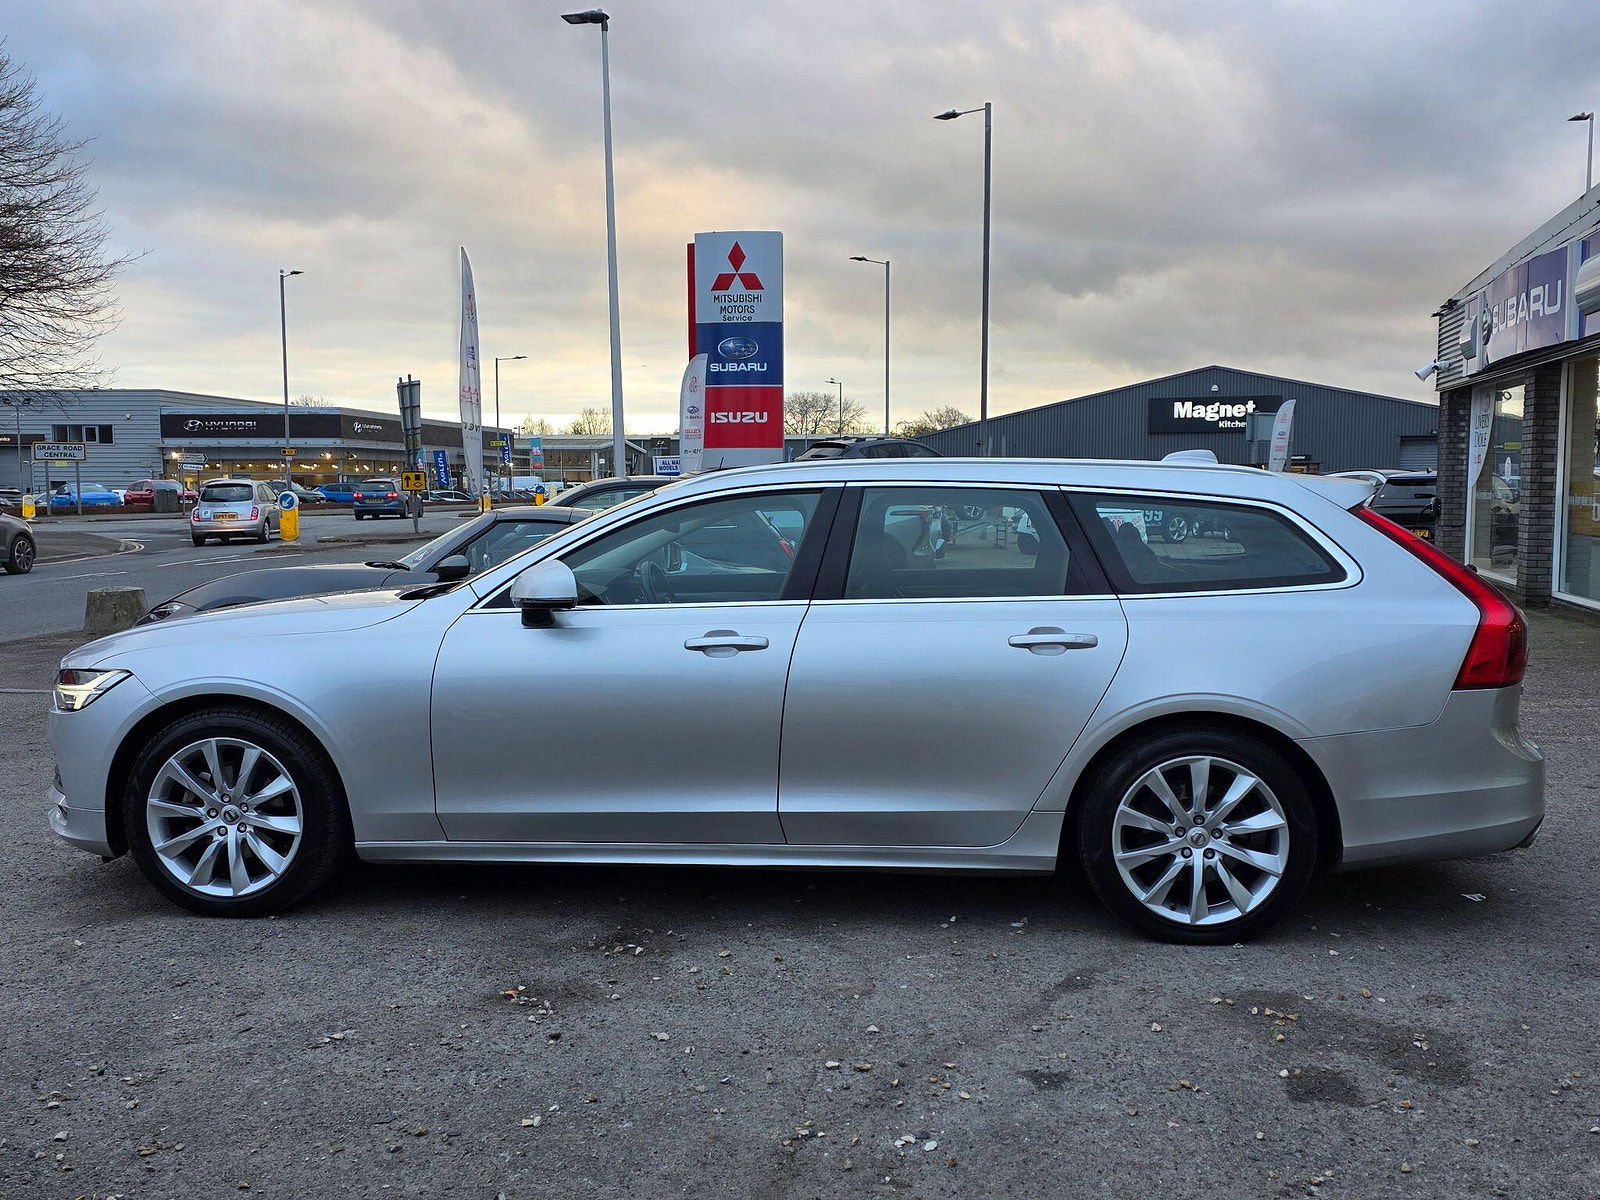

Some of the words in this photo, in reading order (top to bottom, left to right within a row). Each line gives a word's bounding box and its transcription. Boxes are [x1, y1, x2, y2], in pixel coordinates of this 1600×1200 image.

[713, 294, 762, 303] MITSUBISHI
[720, 305, 755, 314] MOTORS
[1492, 279, 1562, 334] SUBARU
[709, 362, 768, 372] SUBARU
[1173, 400, 1256, 421] Magnet
[710, 411, 768, 424] ISUZU
[205, 421, 257, 430] HYUNDAI
